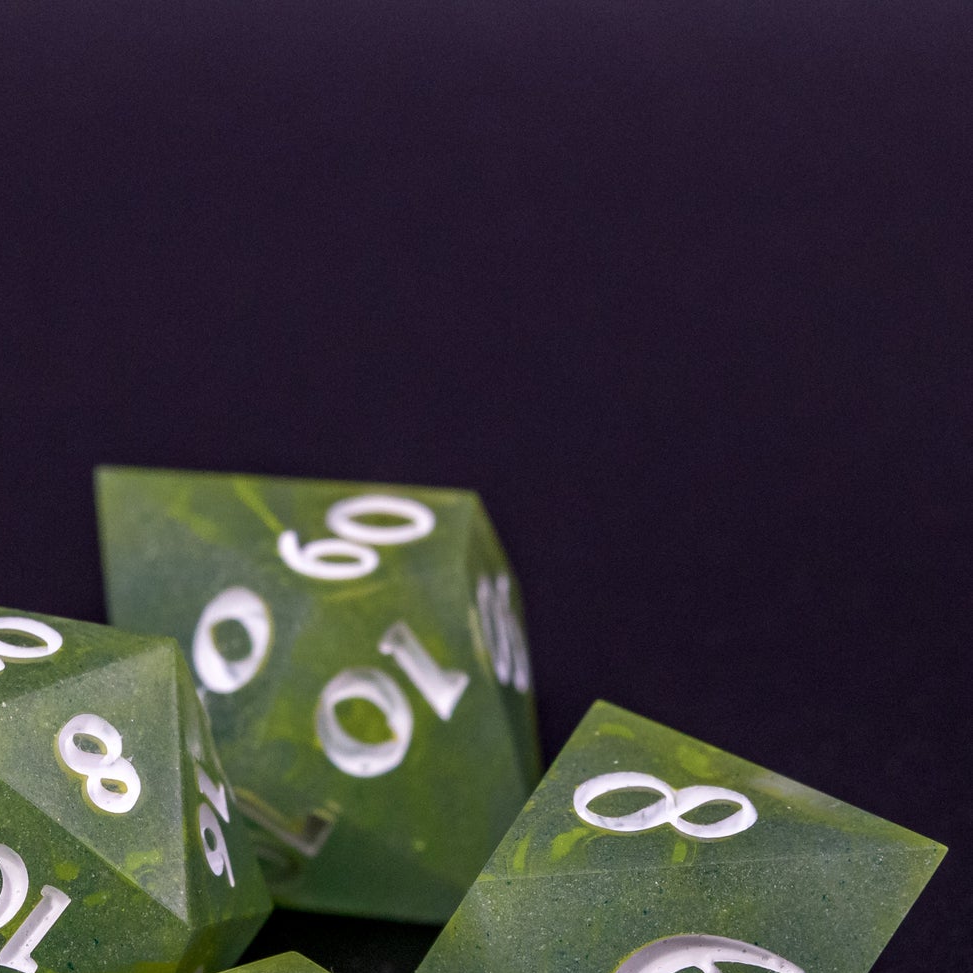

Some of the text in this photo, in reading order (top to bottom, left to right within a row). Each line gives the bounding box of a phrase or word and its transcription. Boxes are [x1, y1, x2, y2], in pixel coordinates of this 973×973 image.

[278, 494, 437, 579] 60
[316, 620, 470, 778] 10
[58, 712, 143, 813] 8
[573, 770, 758, 839] 8
